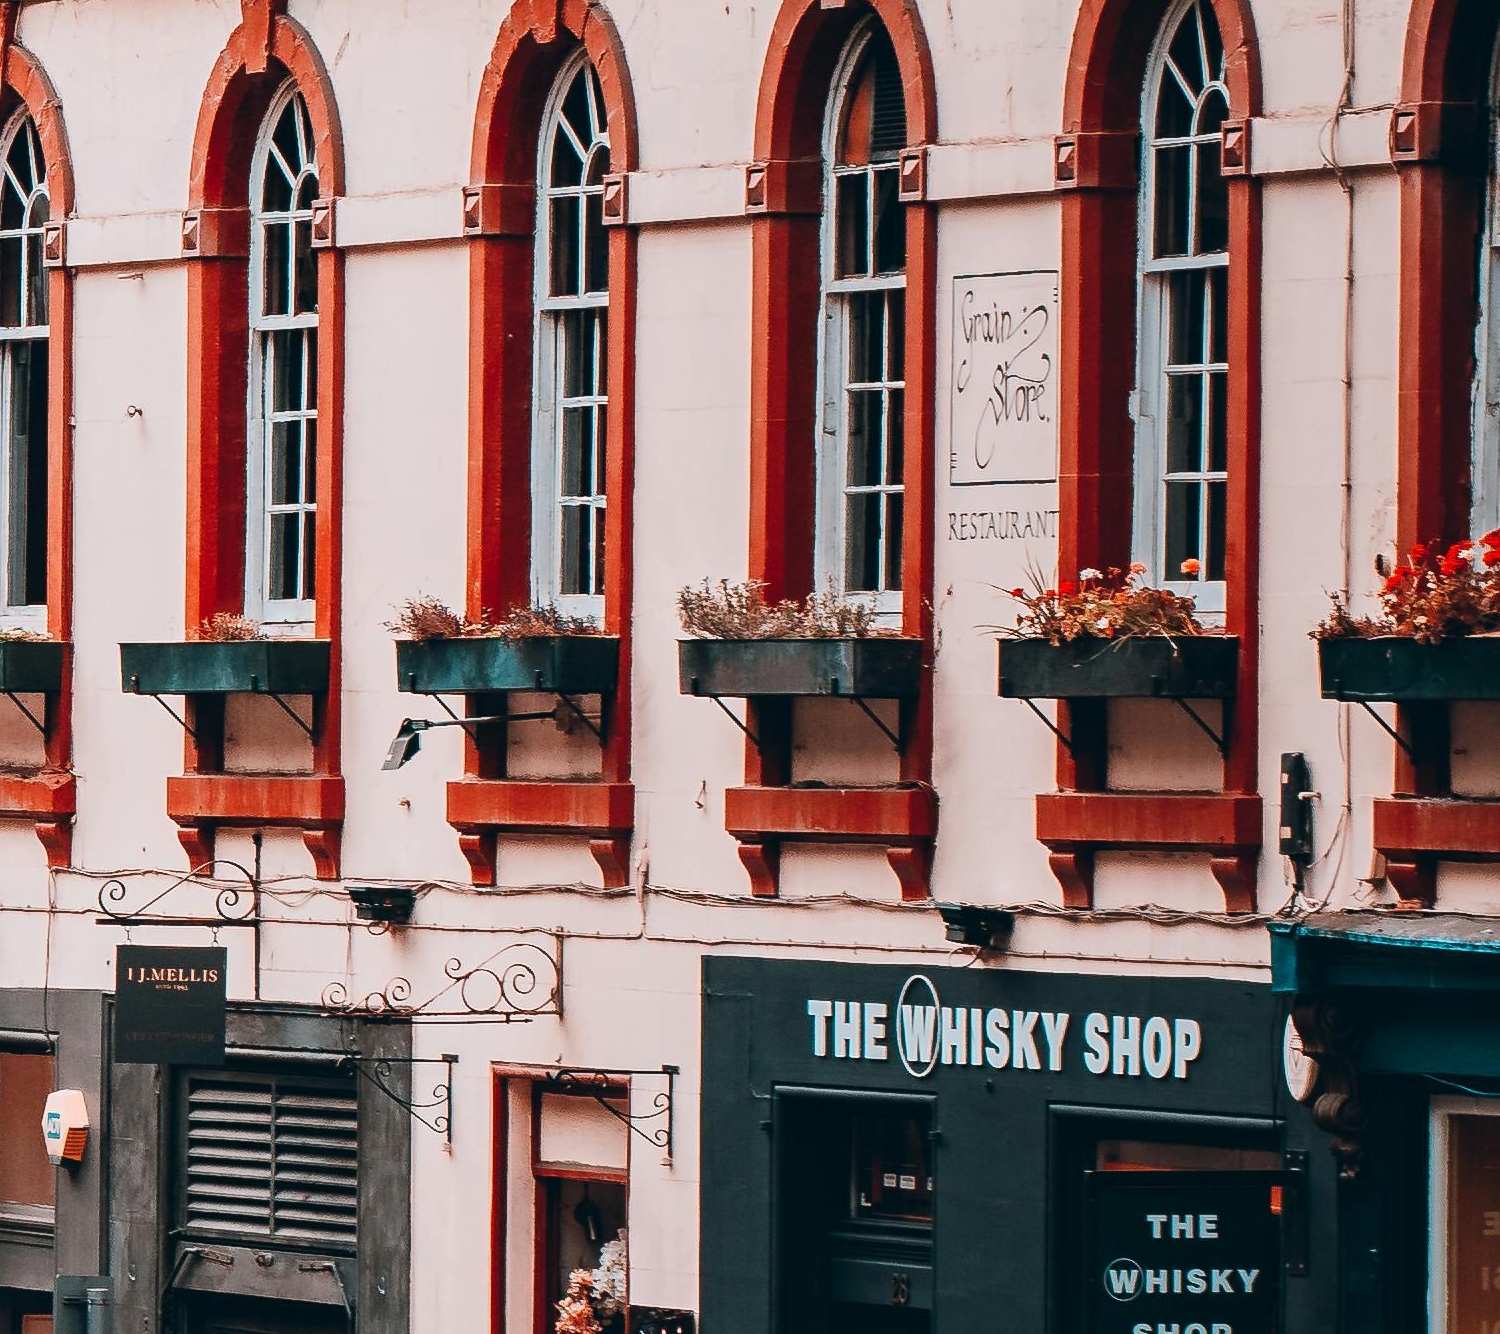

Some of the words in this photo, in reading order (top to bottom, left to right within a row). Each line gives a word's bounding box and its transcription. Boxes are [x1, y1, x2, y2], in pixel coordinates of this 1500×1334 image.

[948, 510, 1060, 541] RESTAURANT
[807, 999, 888, 1060] THE
[900, 1004, 1071, 1072] WHISKY
[1084, 1012, 1202, 1079] SHOP
[1147, 1214, 1219, 1239] THE
[1109, 1269, 1259, 1294] WHISKY
